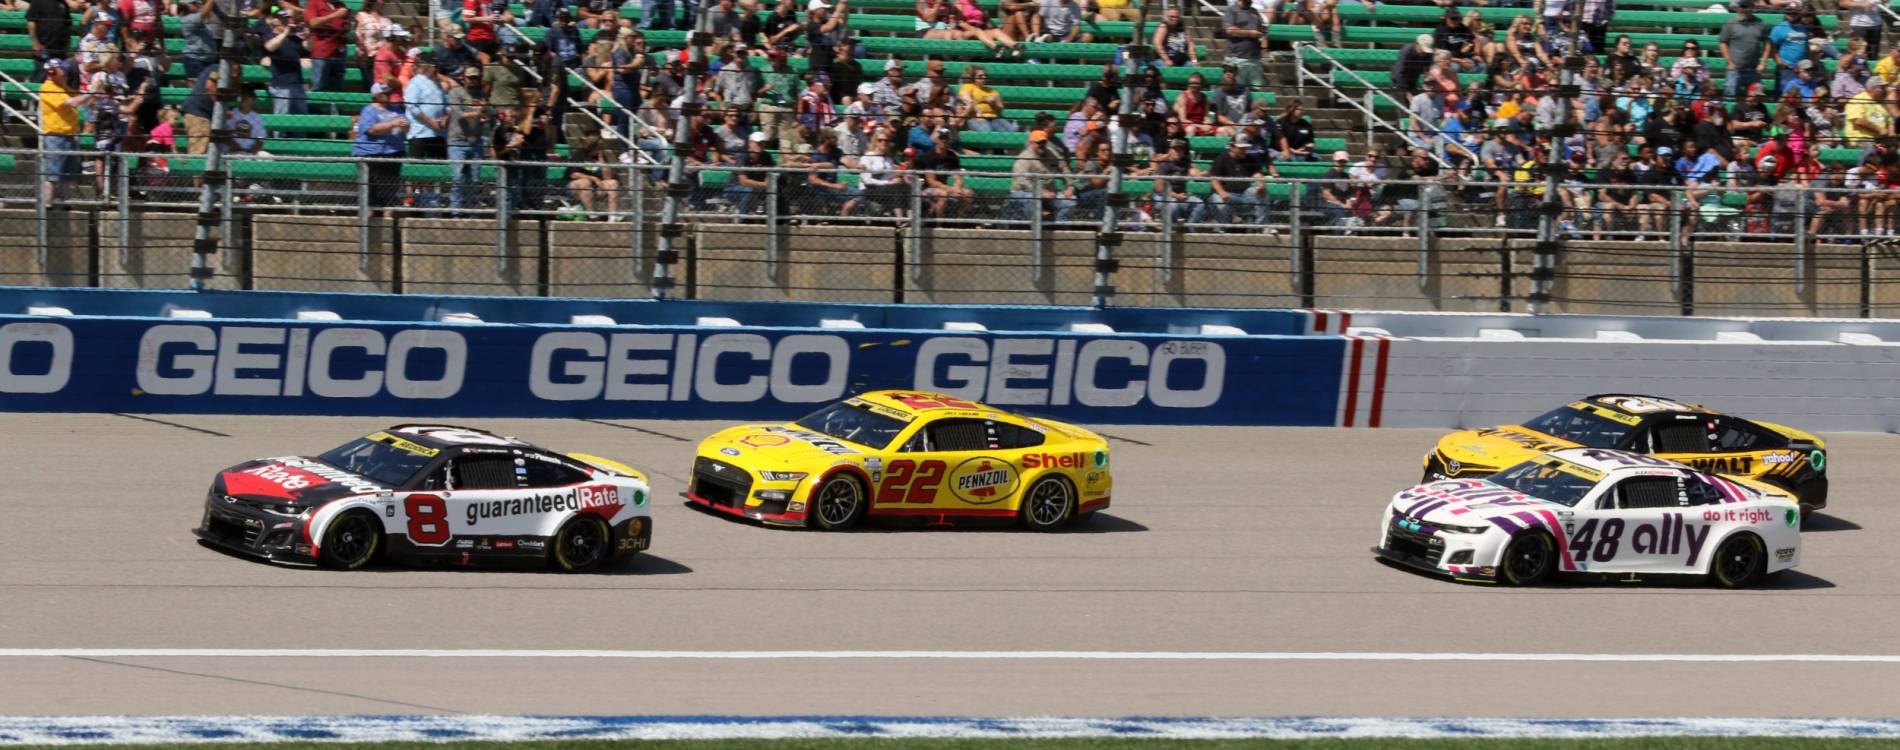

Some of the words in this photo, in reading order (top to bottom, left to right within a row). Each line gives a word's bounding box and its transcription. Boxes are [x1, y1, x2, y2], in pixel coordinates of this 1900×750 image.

[136, 324, 468, 399] GEICO
[528, 331, 851, 404] GEICO
[914, 336, 1227, 408] GEICO
[245, 463, 310, 489] Rate
[1021, 452, 1085, 469] Shell
[1690, 456, 1753, 475] WALT
[1762, 451, 1795, 465] yahoo!
[876, 459, 947, 504] 22
[958, 469, 1009, 490] PENNZOIL
[404, 493, 451, 545] 8
[467, 489, 579, 525] guaranteed
[582, 485, 618, 507] Rate
[1703, 508, 1721, 522] do
[1724, 508, 1736, 521] it
[1739, 508, 1773, 525] right.
[617, 537, 647, 550] 3CHI
[1569, 518, 1625, 562] 48
[1632, 513, 1711, 566] ally
